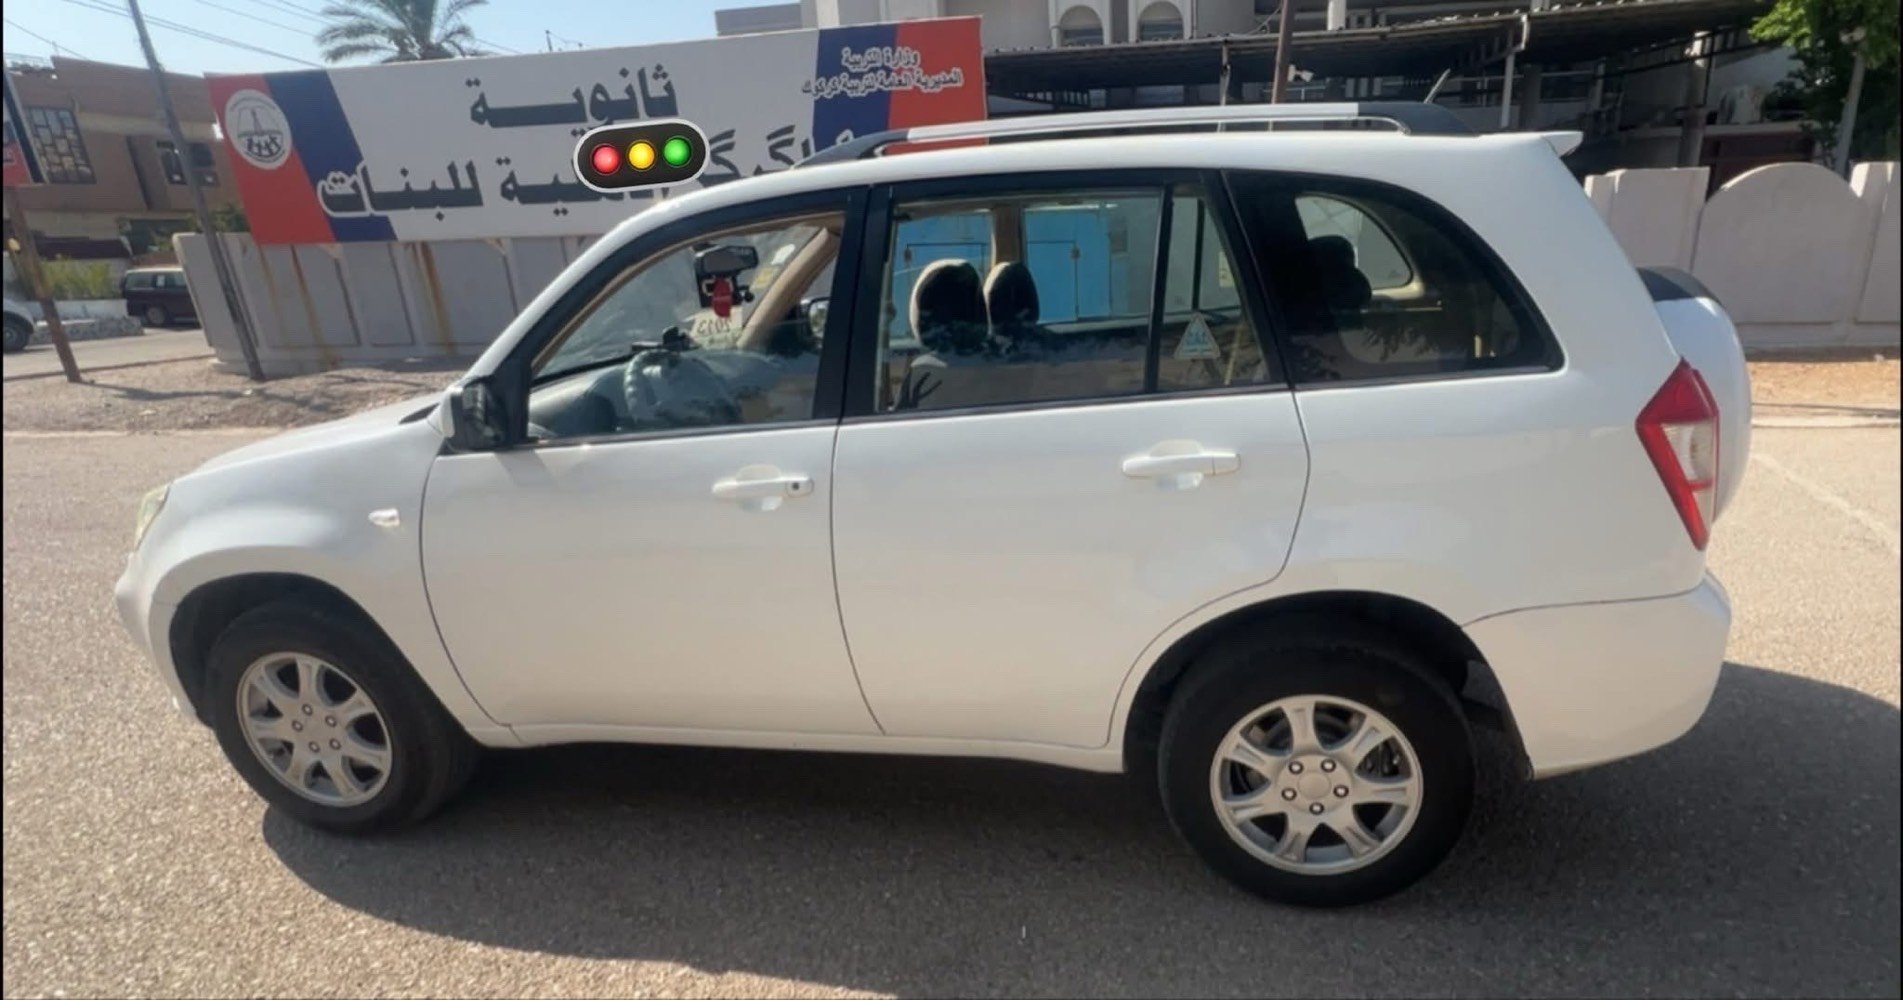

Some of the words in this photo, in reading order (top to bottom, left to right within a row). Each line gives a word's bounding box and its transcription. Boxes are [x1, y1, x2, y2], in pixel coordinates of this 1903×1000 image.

[841, 47, 881, 71] التربية
[884, 47, 920, 68] وزارة
[802, 77, 840, 99] كركوك
[877, 70, 912, 90] العامة
[913, 68, 963, 92] المديرية
[465, 63, 678, 137] ثانوية
[319, 160, 483, 221] للبنات
